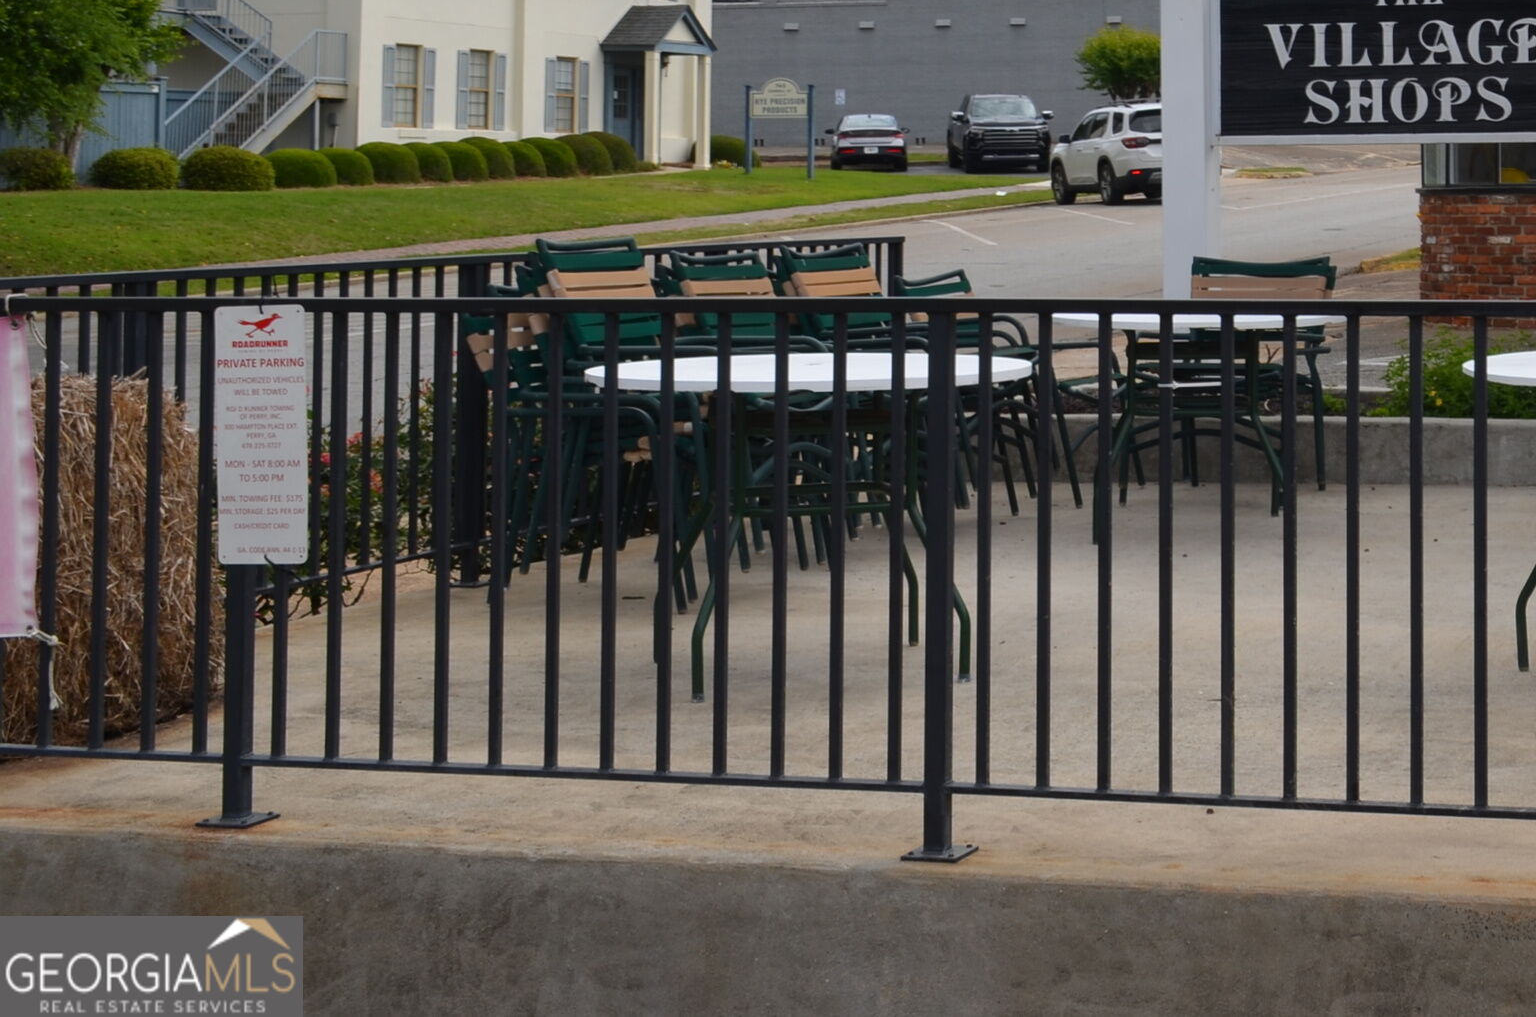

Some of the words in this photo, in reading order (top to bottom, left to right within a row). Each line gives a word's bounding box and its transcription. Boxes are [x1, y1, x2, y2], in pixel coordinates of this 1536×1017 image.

[1304, 76, 1513, 125] SHOPS
[232, 340, 288, 348] ROADRUNNER
[217, 358, 257, 368] PRIVATE
[260, 357, 305, 367] PARKING
[217, 376, 272, 385] UNAUTHORIZED
[273, 375, 304, 384] VEHICLES
[234, 388, 250, 396] WILL
[251, 388, 260, 396] BE
[262, 387, 288, 396] TOWED
[224, 460, 245, 468] MON
[252, 460, 265, 468] SAT
[267, 460, 286, 468] 8:00
[286, 459, 301, 468] AM
[239, 474, 250, 482] TO
[251, 474, 270, 482] 5:00
[271, 474, 285, 482] PM
[221, 495, 238, 503] MIN.
[239, 495, 268, 503] TOWING
